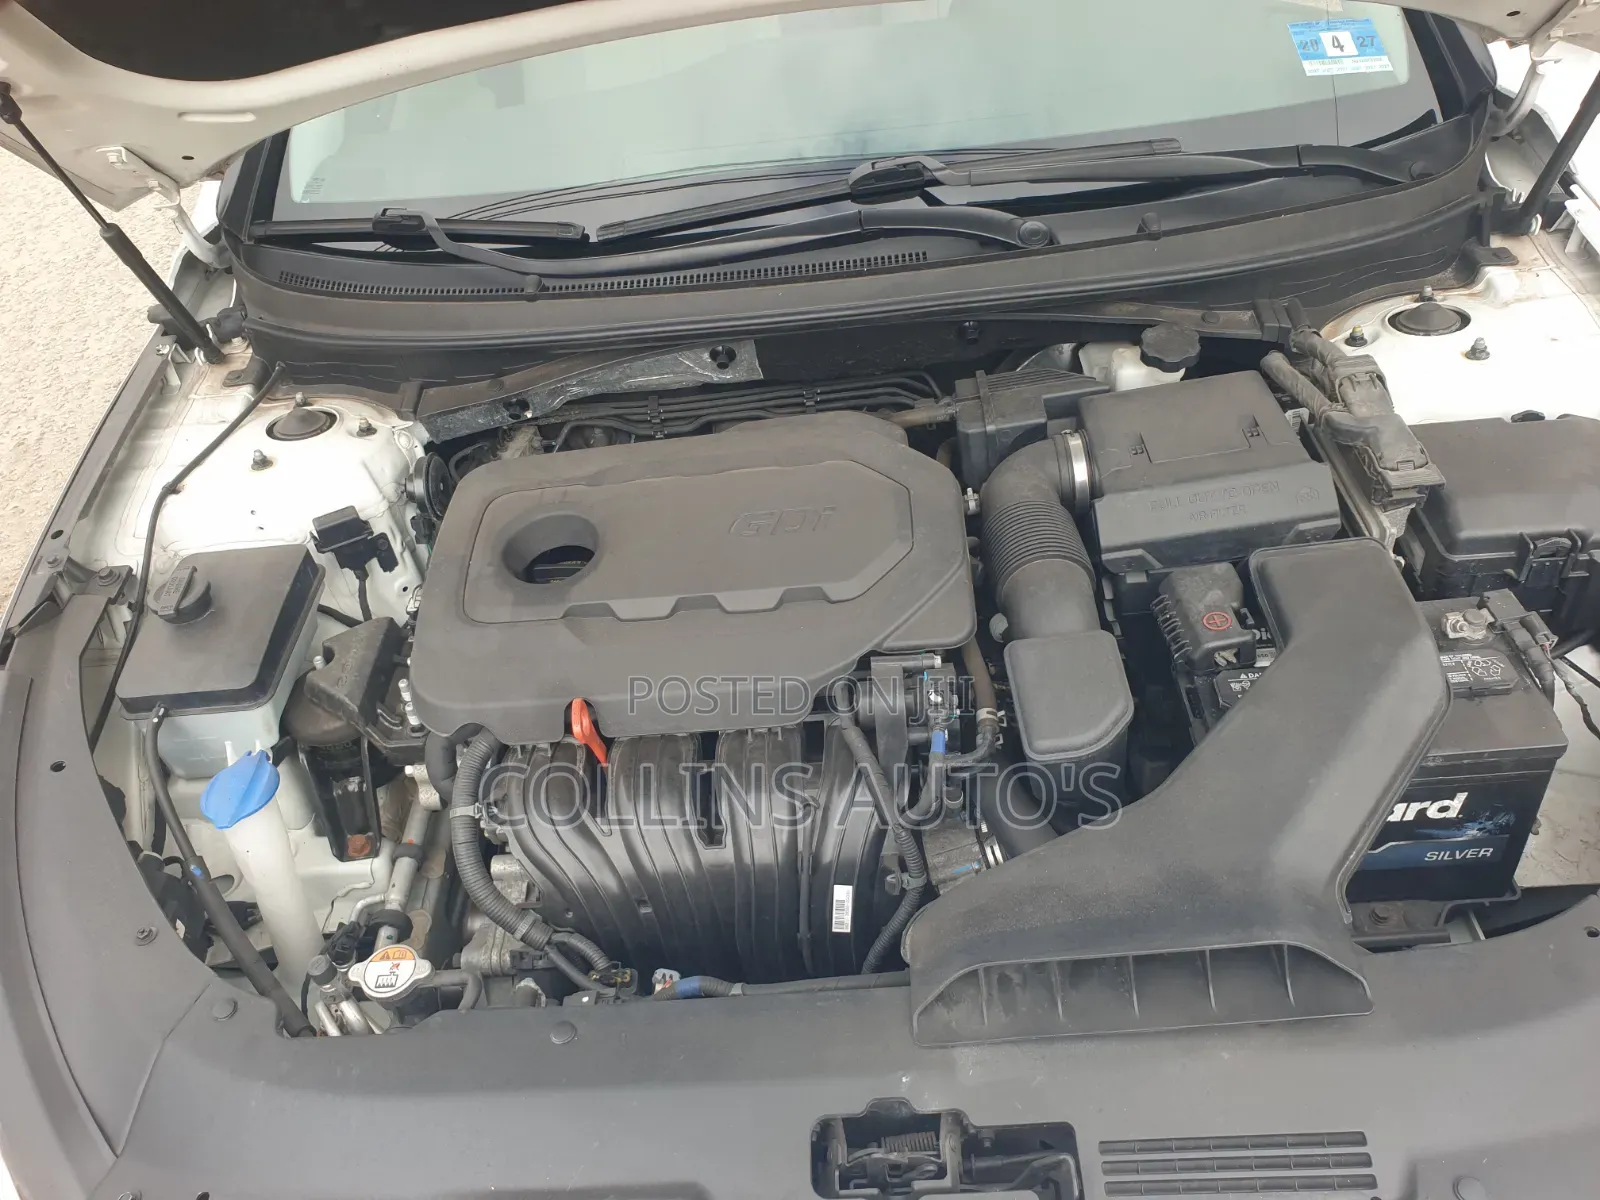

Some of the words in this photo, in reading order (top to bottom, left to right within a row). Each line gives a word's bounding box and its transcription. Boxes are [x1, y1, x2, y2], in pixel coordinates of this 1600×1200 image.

[1331, 35, 1345, 53] 4
[1356, 35, 1376, 48] 27
[1242, 480, 1281, 496] OPEN
[1424, 847, 1494, 861] SILVER
